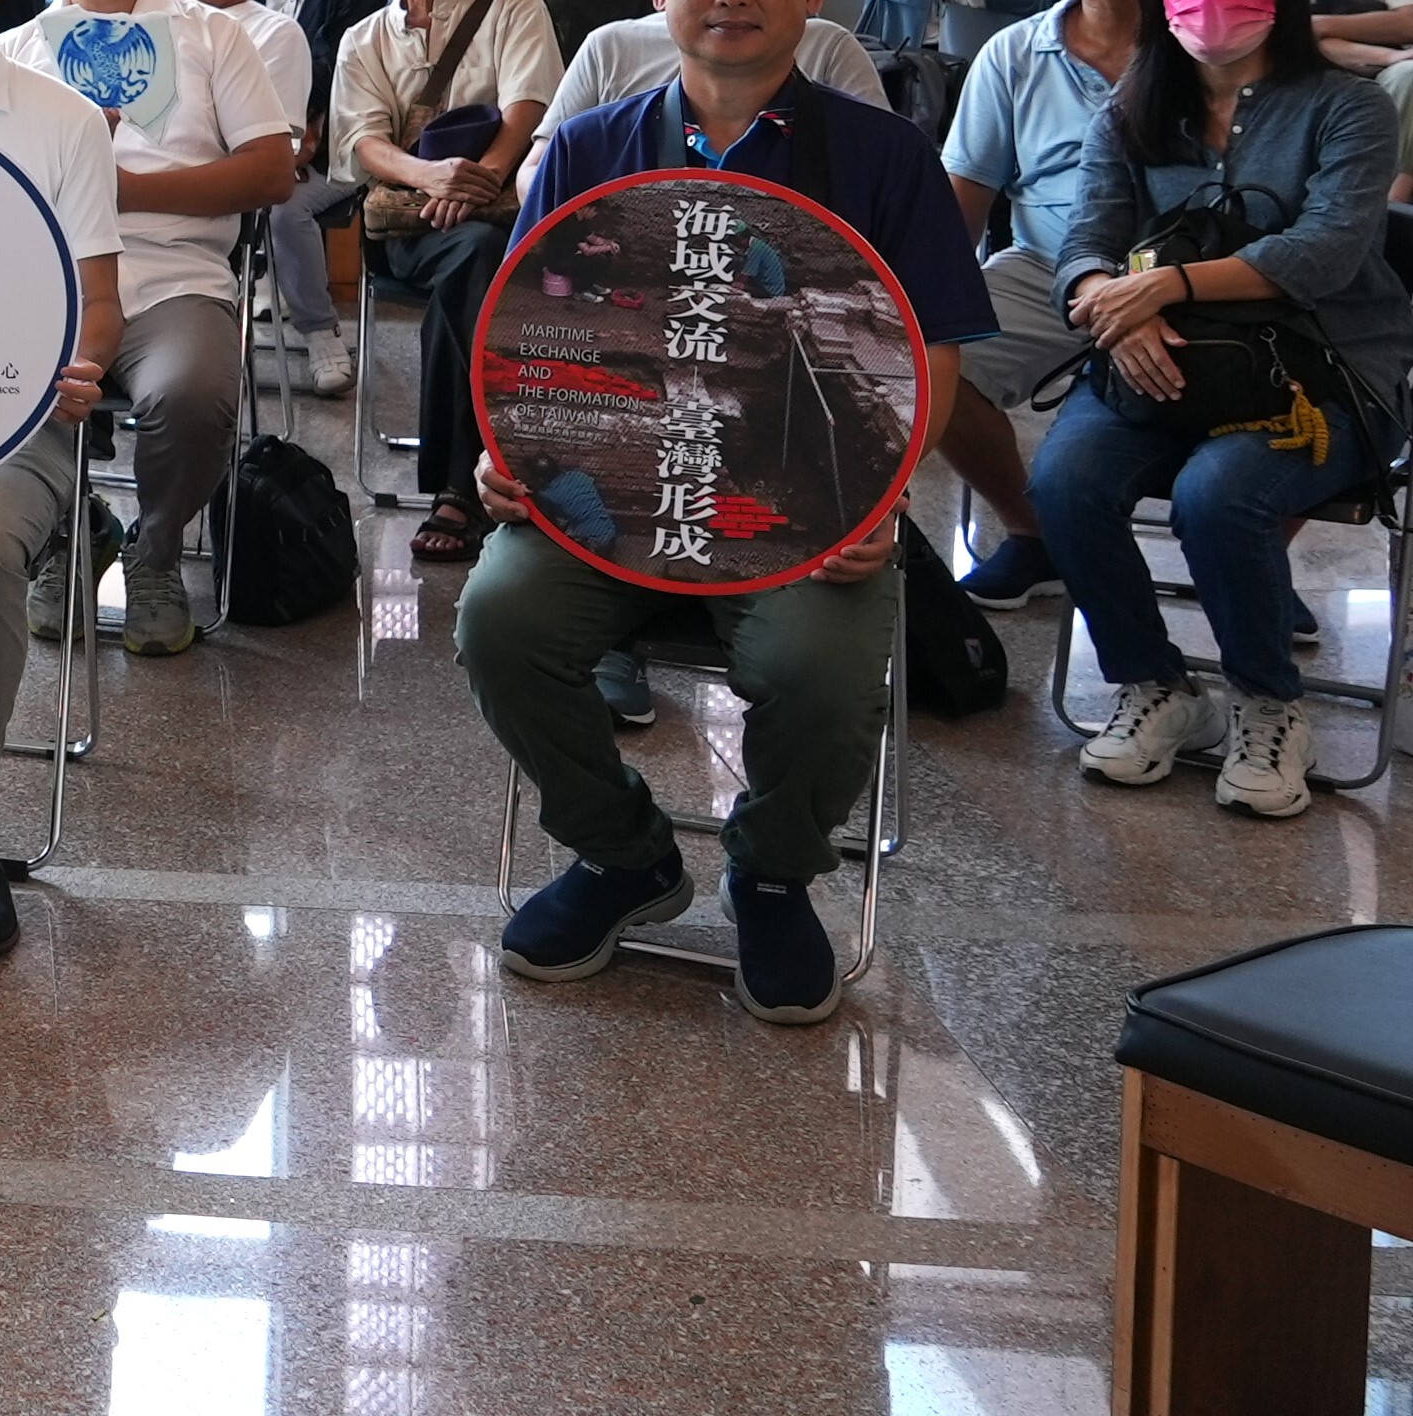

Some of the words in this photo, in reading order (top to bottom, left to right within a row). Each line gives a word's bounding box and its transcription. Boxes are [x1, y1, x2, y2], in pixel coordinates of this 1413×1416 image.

[521, 323, 594, 343] MARITIME
[519, 342, 601, 363] EXCHANGE
[518, 364, 552, 380] AND
[516, 383, 545, 399] THE
[548, 387, 640, 410] FORMATION
[515, 403, 535, 416] OF
[539, 405, 600, 425] TAIWAN
